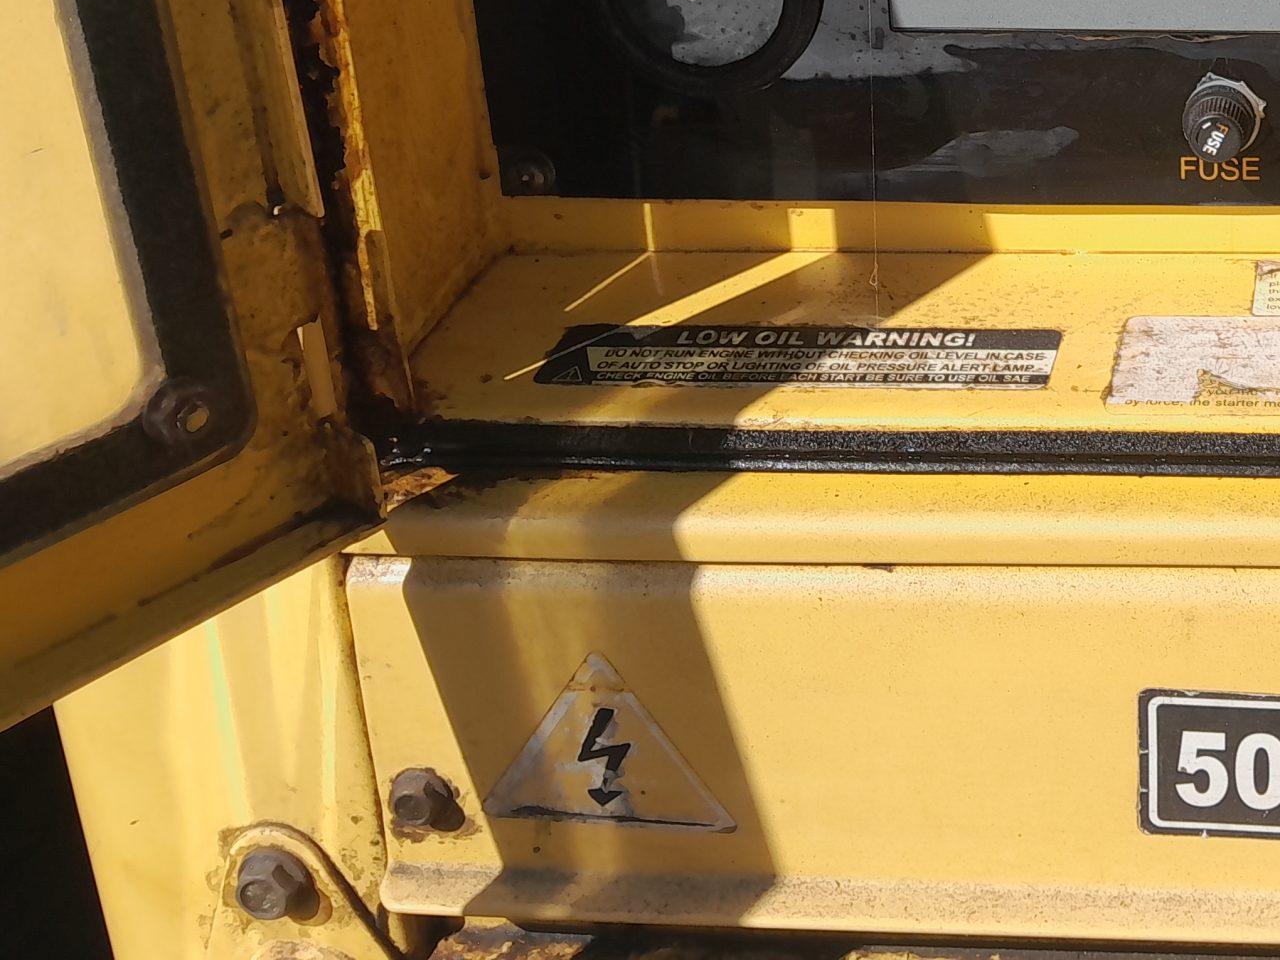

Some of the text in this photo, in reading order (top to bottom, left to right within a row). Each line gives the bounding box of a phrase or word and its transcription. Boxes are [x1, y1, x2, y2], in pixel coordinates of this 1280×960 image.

[1202, 122, 1230, 156] FUSE
[1179, 155, 1261, 182] FUSE
[676, 329, 977, 347] LOW OIL WARNING!
[597, 360, 620, 371] OF
[620, 360, 660, 371] AUTO
[665, 361, 706, 371] STOP
[706, 361, 731, 371] OR
[732, 361, 802, 372] LIGHTING
[804, 361, 824, 372] OF
[829, 362, 852, 372] OIL
[856, 362, 936, 373] PRESSURE
[939, 362, 990, 373] ALERT
